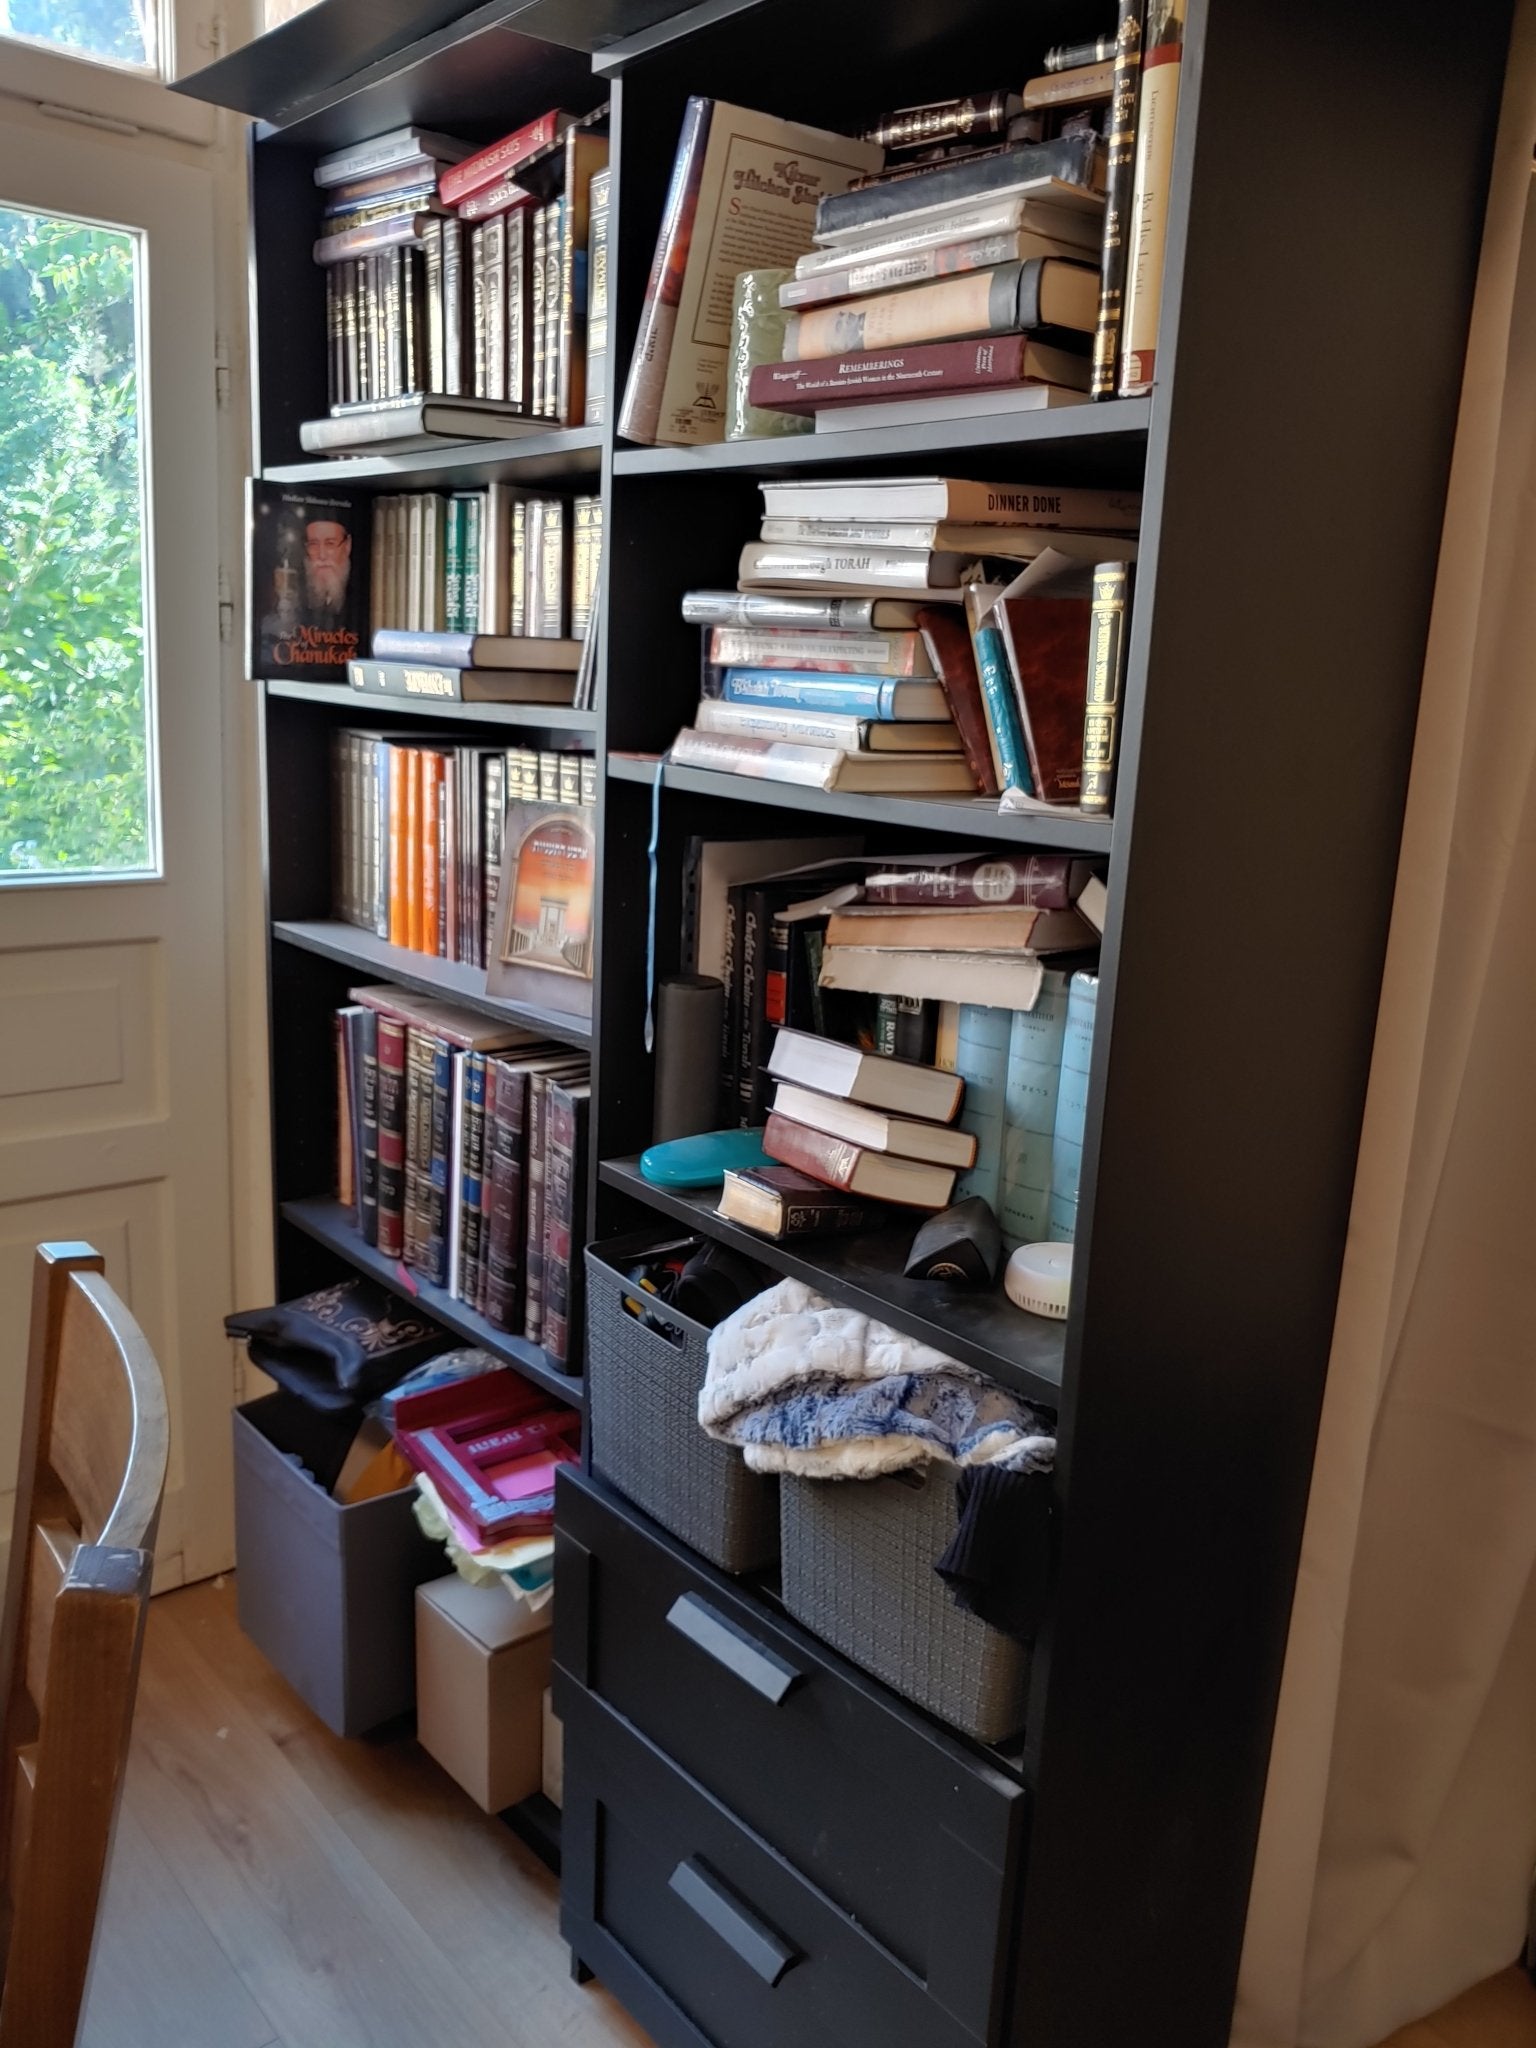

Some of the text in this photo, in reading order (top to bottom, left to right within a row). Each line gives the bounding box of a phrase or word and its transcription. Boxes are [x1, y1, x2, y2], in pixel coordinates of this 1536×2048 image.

[988, 493, 1029, 513] DINNER
[1033, 495, 1062, 514] DONE
[835, 557, 871, 570] TORAH
[300, 624, 359, 645] Miracles
